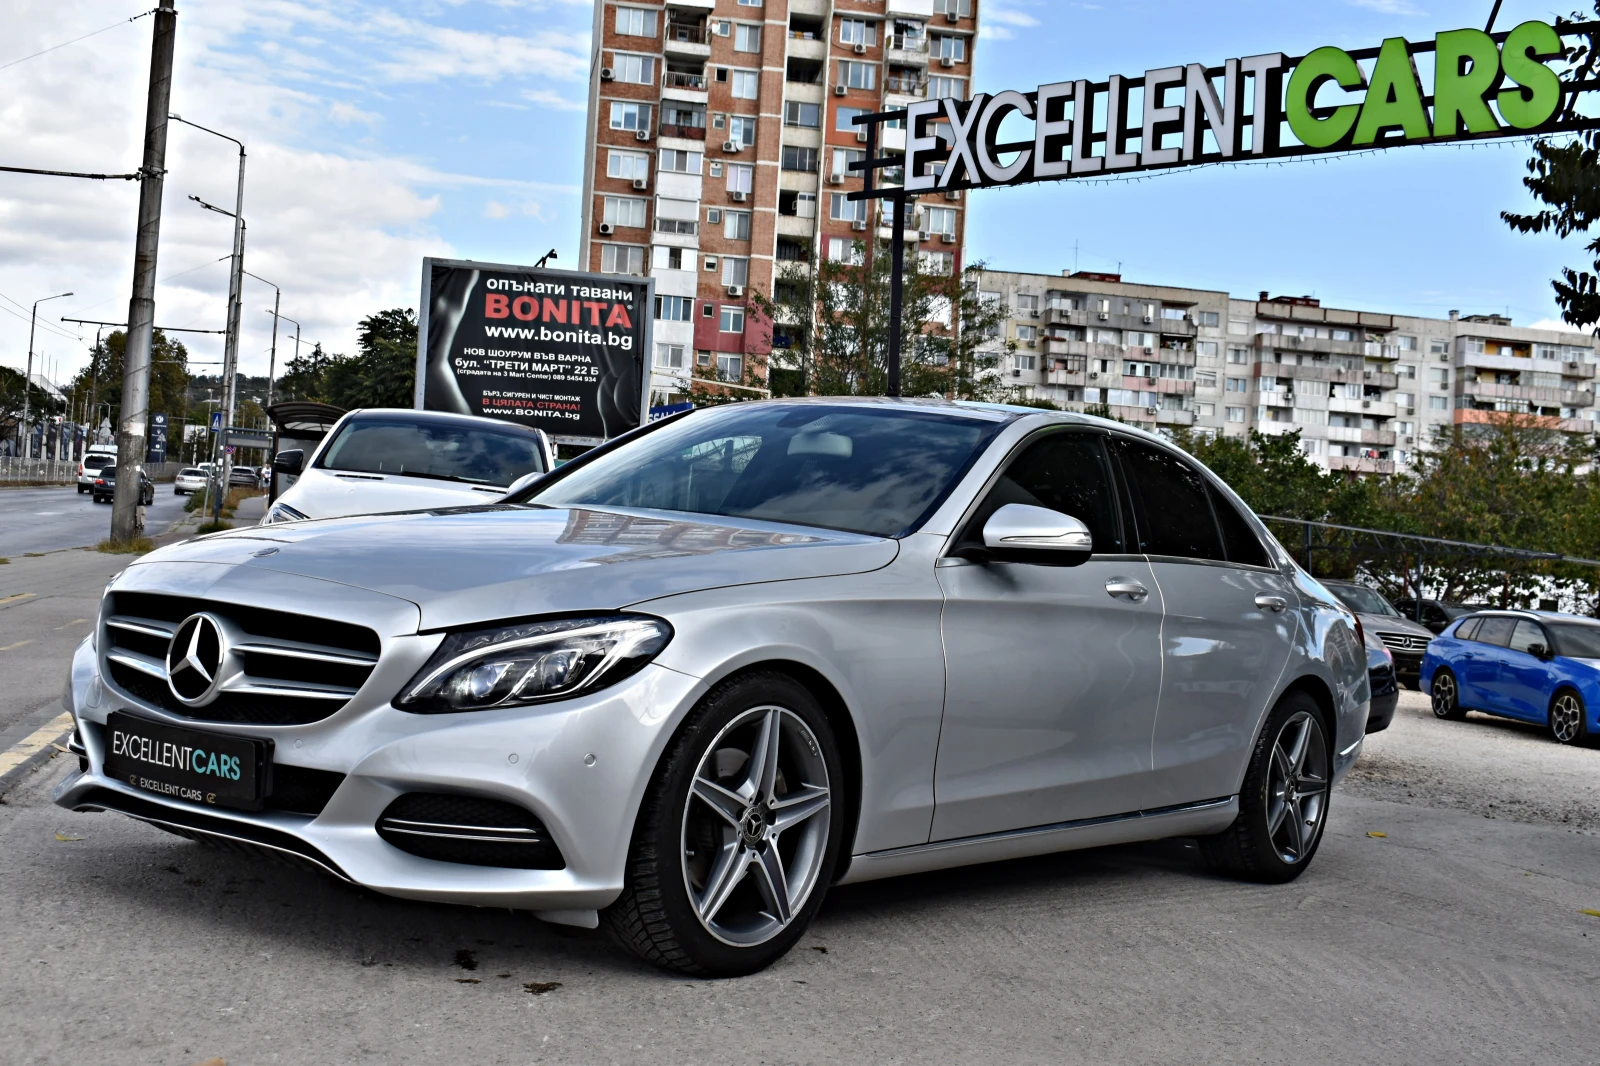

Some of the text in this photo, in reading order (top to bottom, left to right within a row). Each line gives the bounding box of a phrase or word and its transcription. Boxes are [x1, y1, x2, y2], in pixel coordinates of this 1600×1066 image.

[486, 278, 633, 301] опънати тавани
[484, 293, 632, 329] BONITA
[484, 325, 633, 350] www.bonita.bg
[463, 347, 592, 363] НОВ ШОУРУМ ВЪВ ВАРНА
[455, 357, 481, 369] бул.
[574, 365, 587, 375] 22
[590, 366, 599, 376] Б
[456, 368, 491, 377] (сградата
[509, 371, 525, 379] Mart
[526, 372, 551, 381] Center)
[584, 375, 597, 383] 934
[492, 399, 534, 408] ЦЯЛАТА
[536, 401, 580, 411] СТРАНА!
[502, 391, 531, 399] СИГУРЕН
[553, 394, 581, 402] МОНТАЖ
[482, 407, 581, 420] www.BONITA.bg
[140, 777, 180, 796] EXCELLENT
[180, 787, 202, 801] CARS
